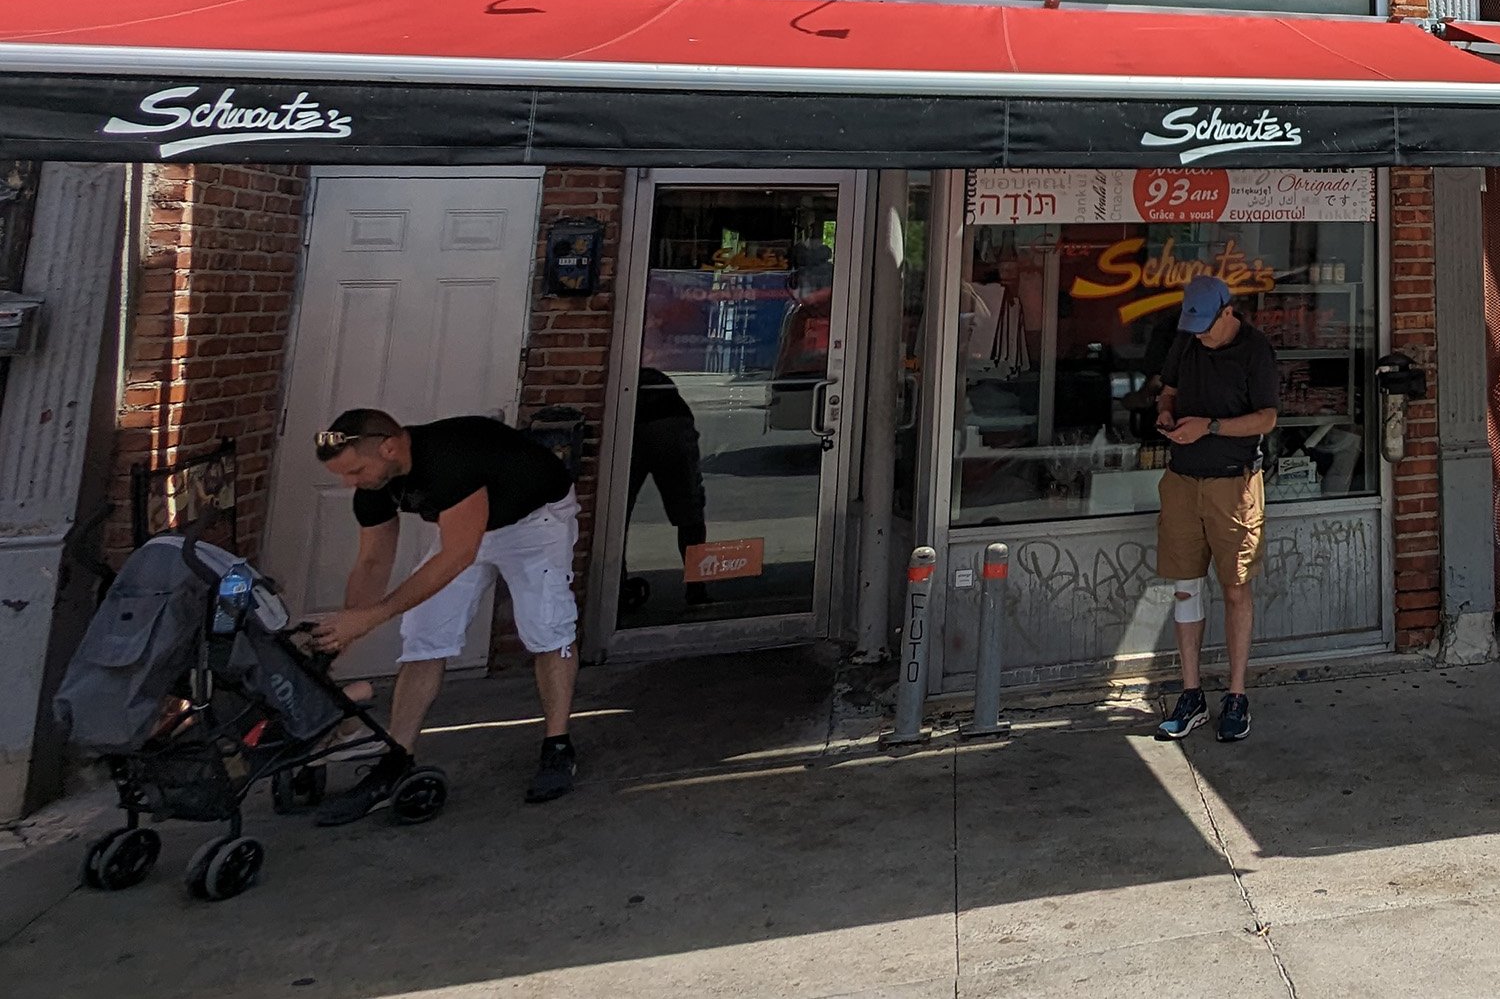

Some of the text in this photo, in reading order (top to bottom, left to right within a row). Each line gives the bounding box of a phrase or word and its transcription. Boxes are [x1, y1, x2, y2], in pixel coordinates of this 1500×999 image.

[103, 87, 352, 158] Schwartz's
[1141, 106, 1302, 164] Schwartz's
[1144, 178, 1219, 207] 93 ans
[1278, 174, 1357, 196] Obrigado!
[1149, 209, 1174, 219] Grâce
[1190, 209, 1214, 219] vous!
